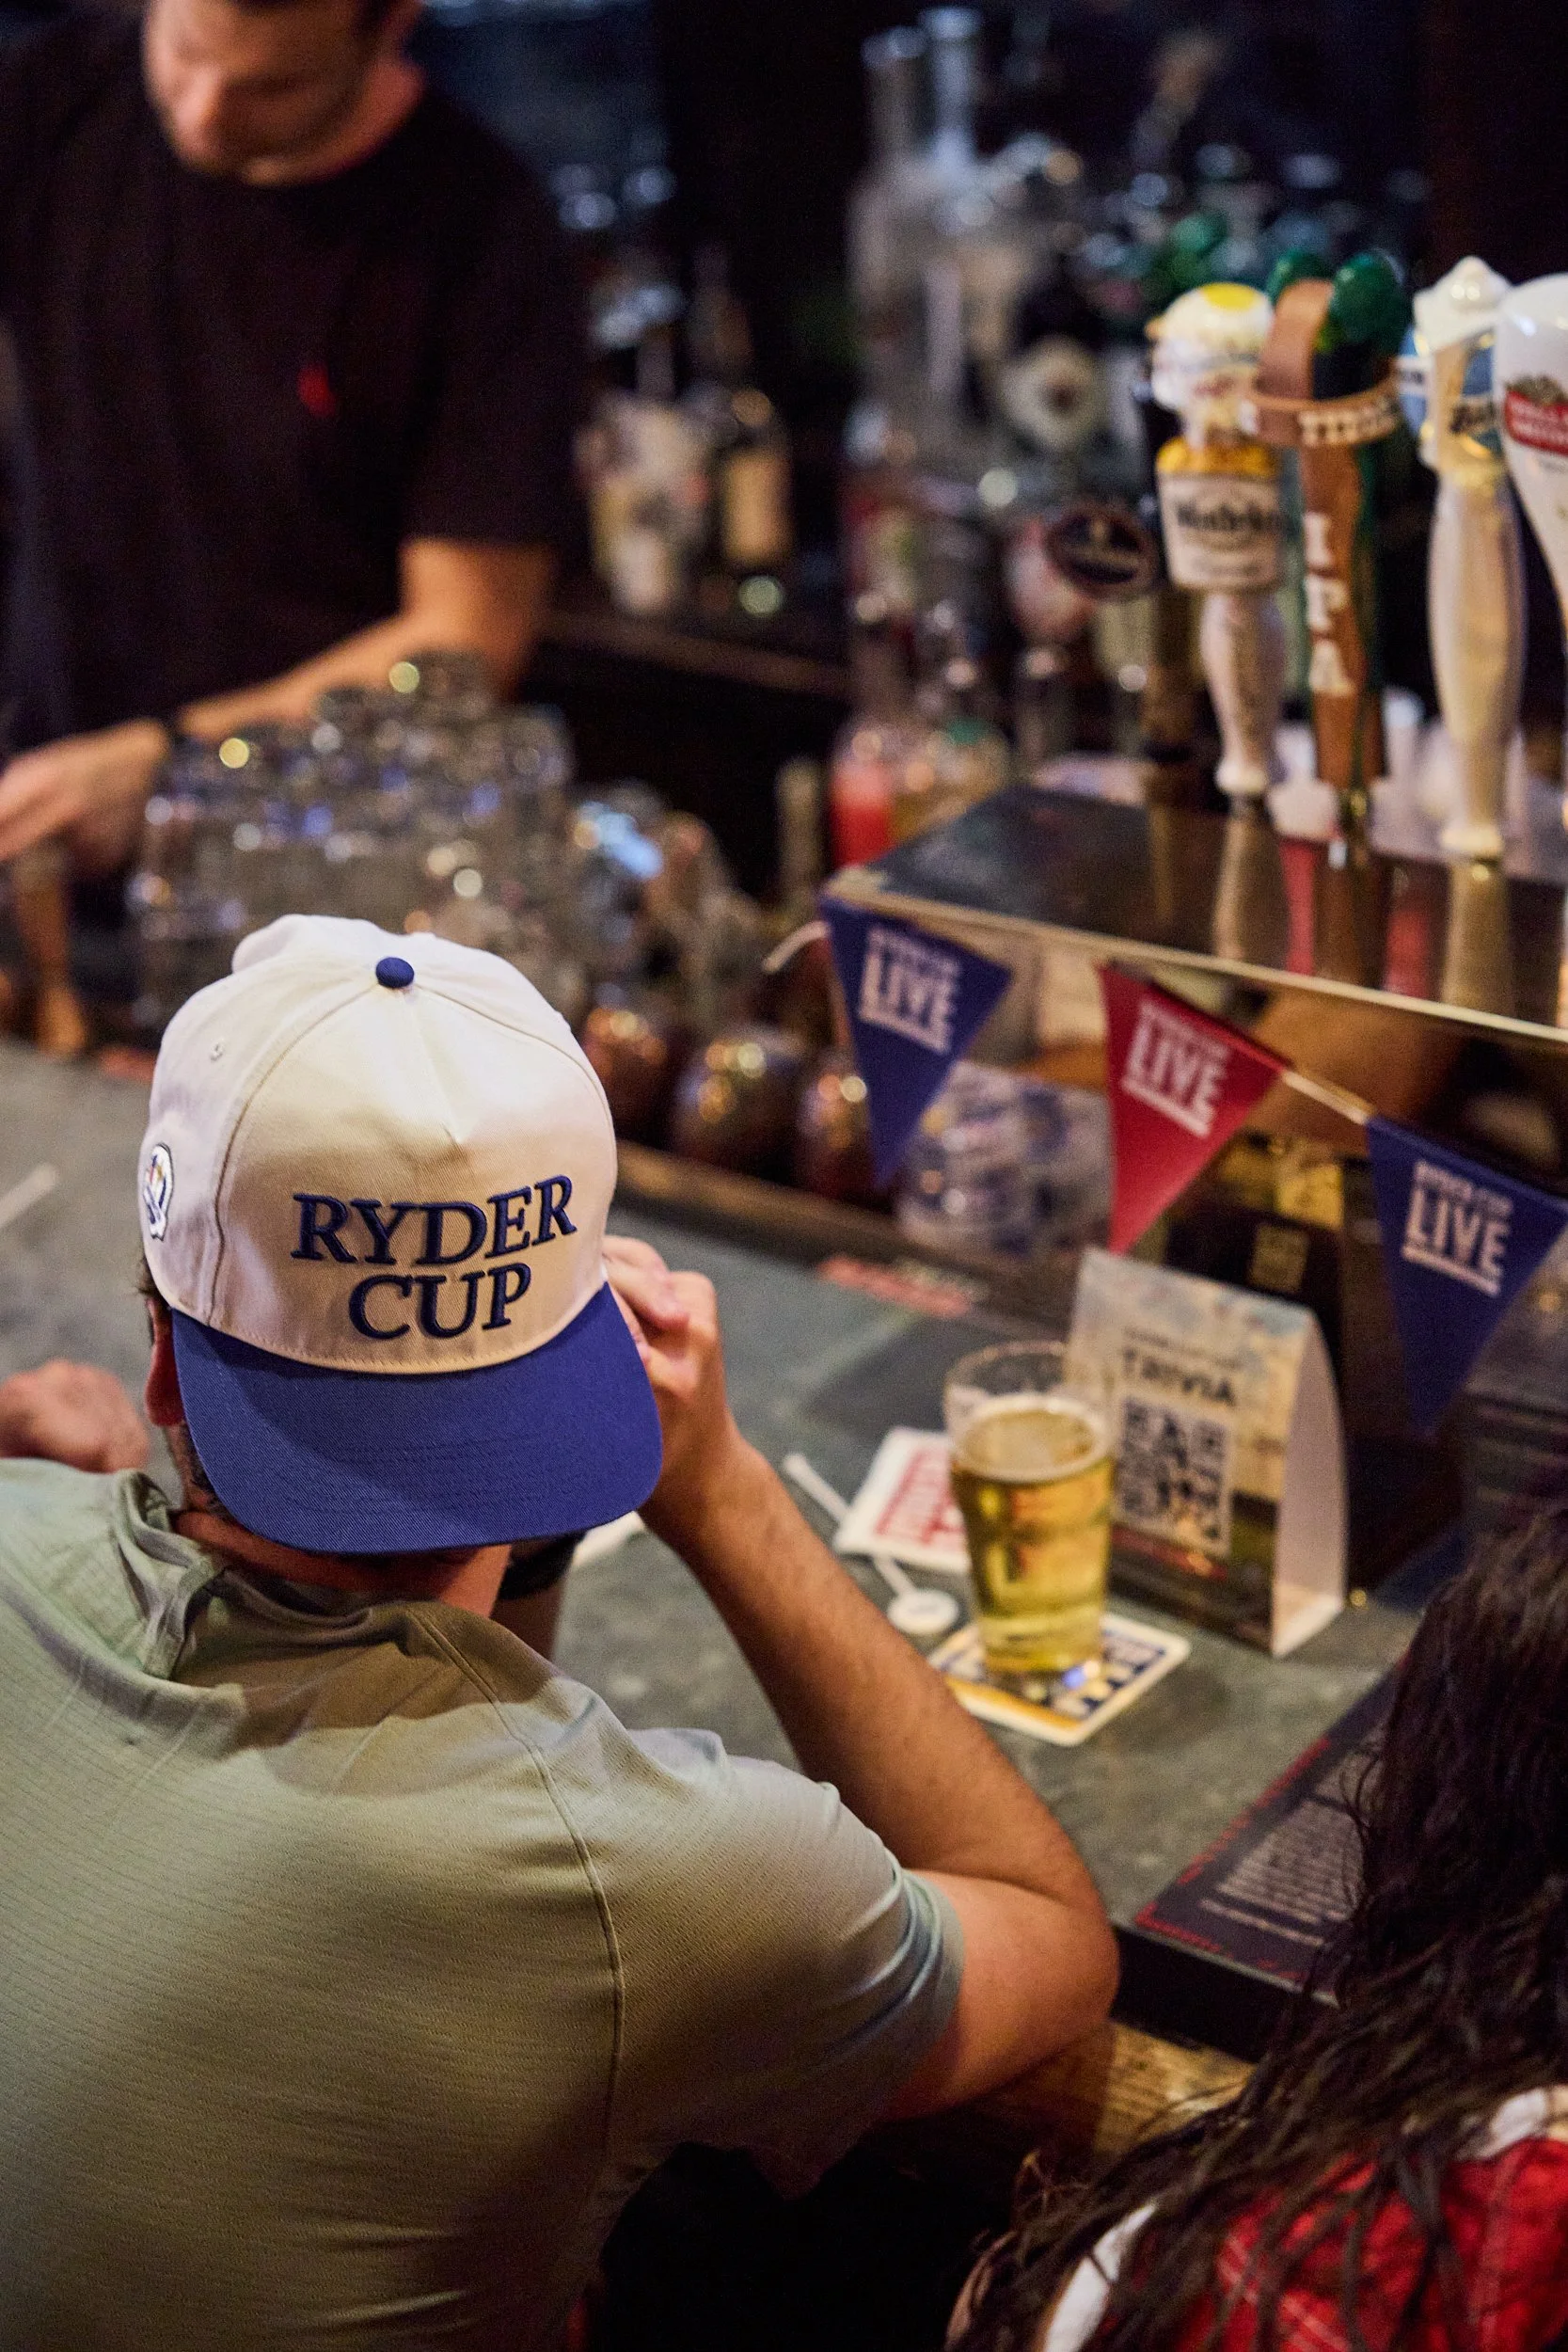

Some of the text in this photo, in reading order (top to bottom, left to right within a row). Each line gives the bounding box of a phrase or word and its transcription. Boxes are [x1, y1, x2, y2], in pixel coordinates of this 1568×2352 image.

[1304, 513, 1356, 696] IPA
[860, 951, 958, 1042] LIVE
[1125, 1022, 1228, 1122] LIVE
[290, 1174, 578, 1265] RYDER
[1405, 1187, 1510, 1278] LIVE
[347, 1262, 532, 1341] CUP
